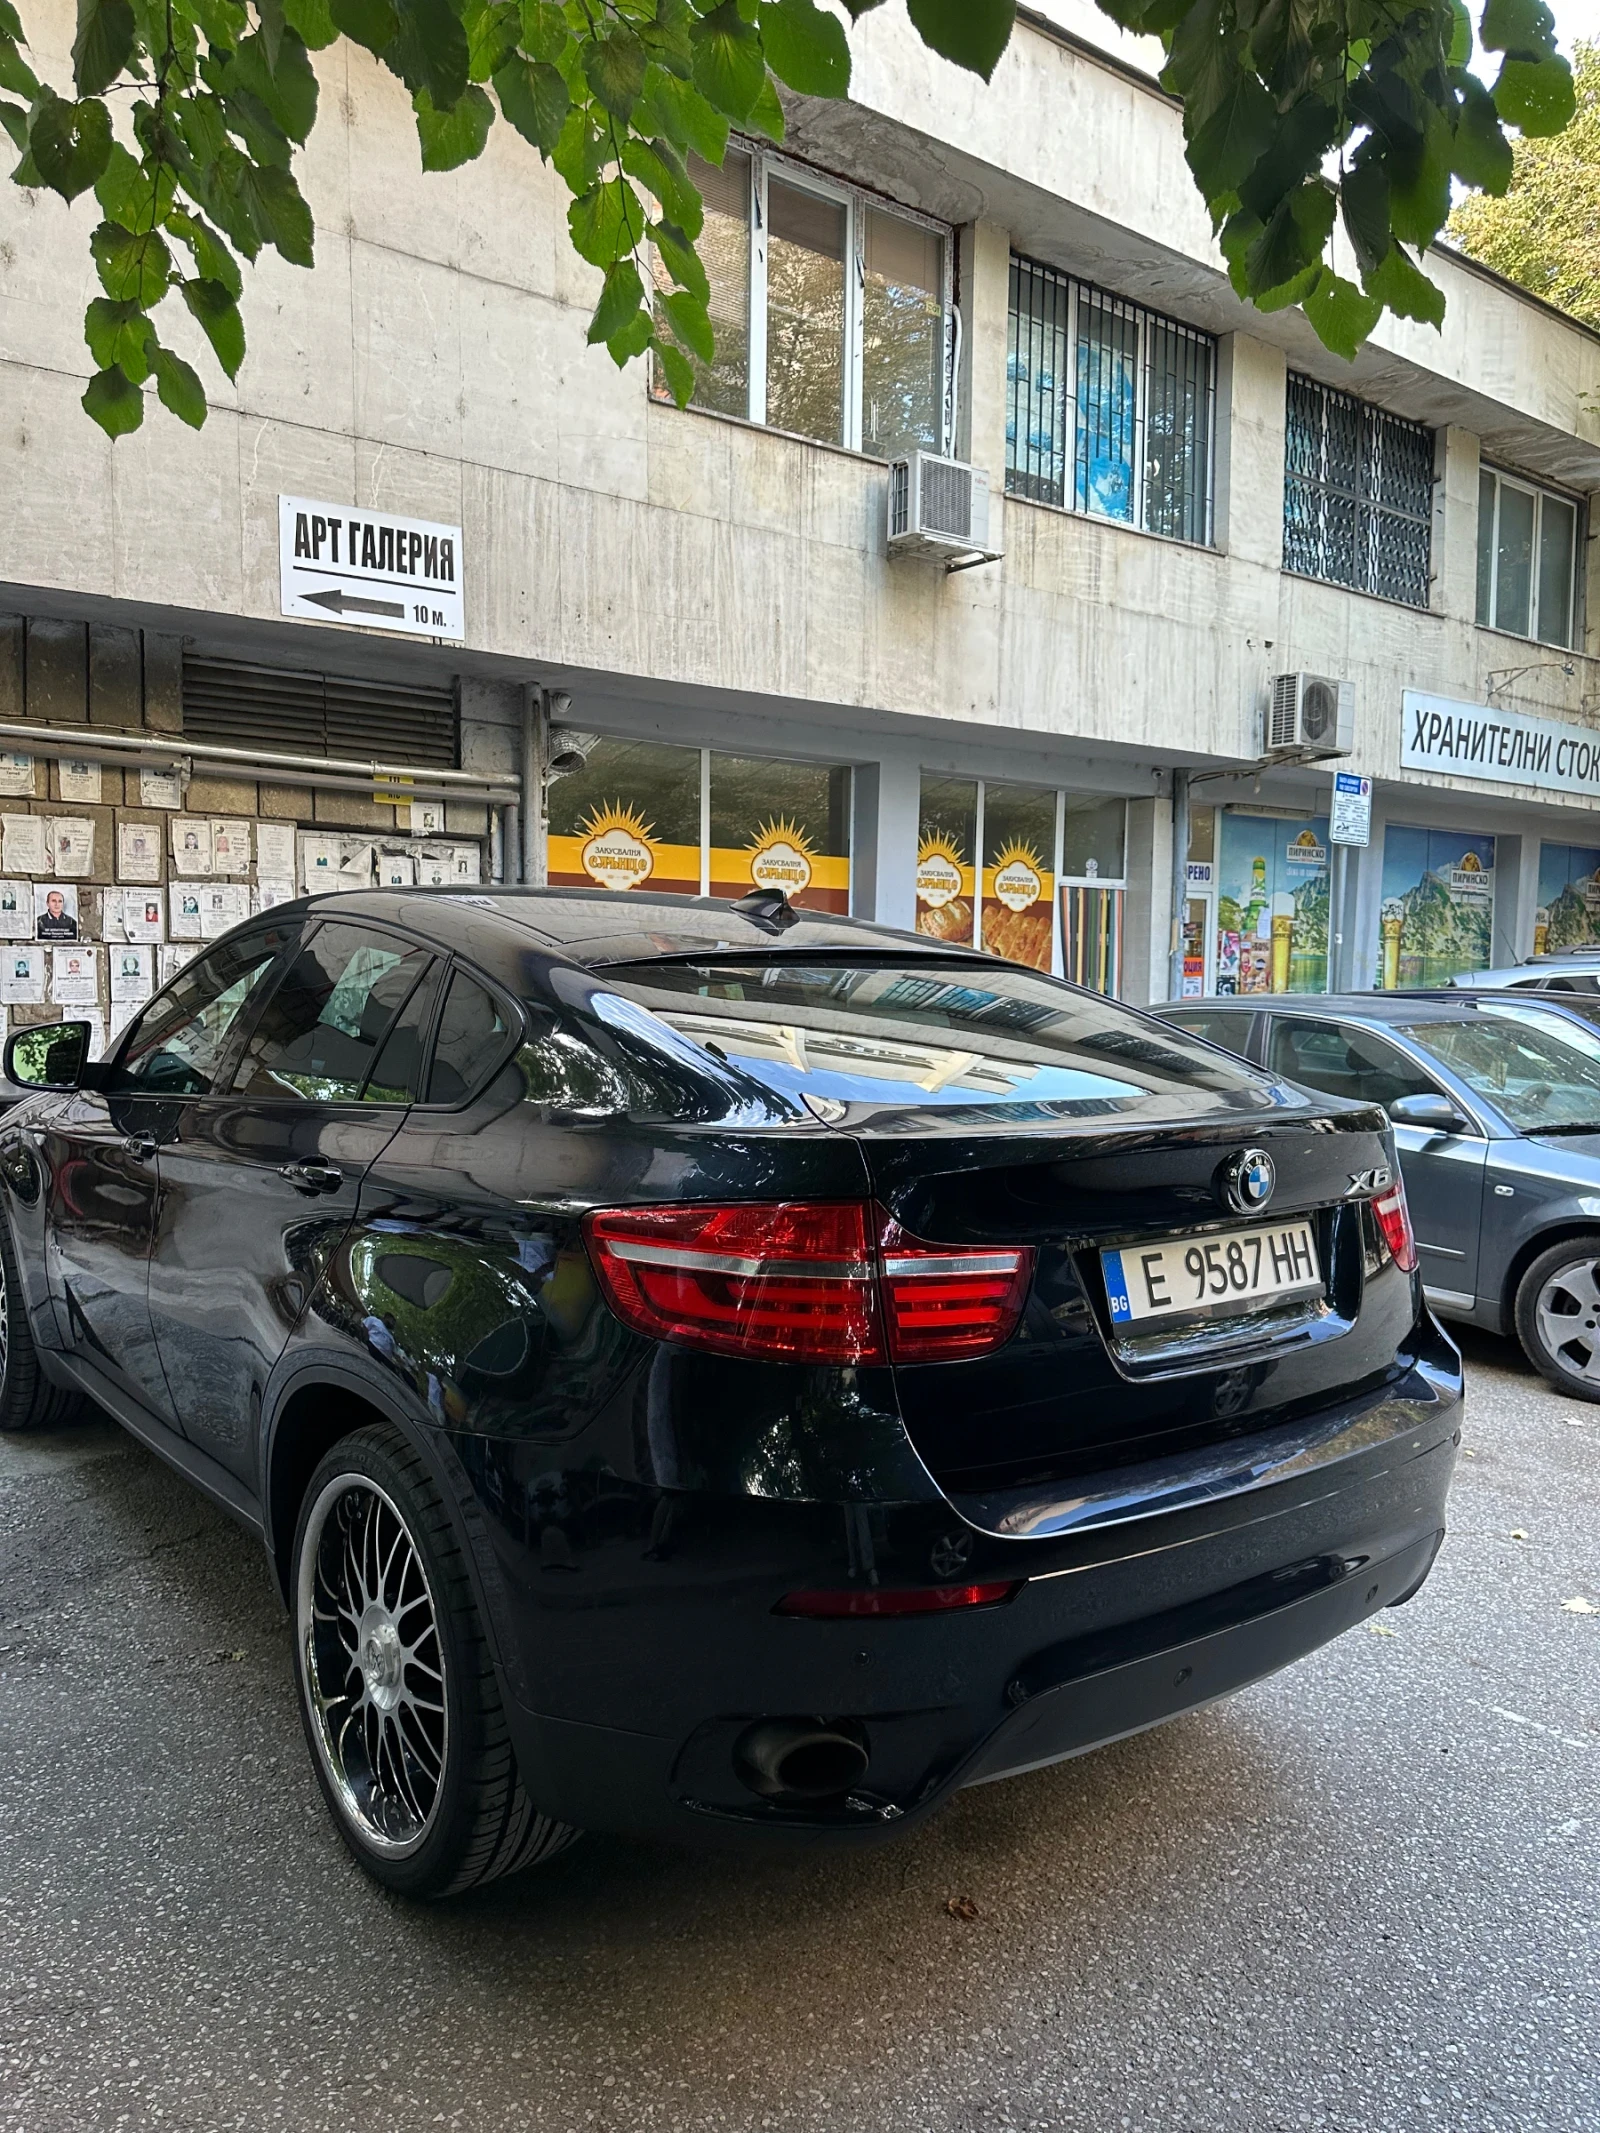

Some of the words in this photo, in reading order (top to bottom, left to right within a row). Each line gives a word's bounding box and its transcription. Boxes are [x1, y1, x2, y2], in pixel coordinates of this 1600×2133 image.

[295, 512, 342, 563] АРТ
[349, 520, 454, 582] ГАЛЕРИЯ
[413, 604, 429, 624] 10
[1411, 709, 1552, 773] ХРАНИТЕЛНИ
[595, 846, 641, 857] ЗАКУСВАЛНЯ
[761, 858, 802, 868] ЗАКУСВАЛНЯ
[1188, 865, 1210, 881] РЕНО
[1452, 872, 1488, 885] ПИРИНСКО
[1184, 960, 1202, 974] ОЦИЯ
[1343, 1165, 1390, 1196] X6
[1141, 1252, 1172, 1308] E
[1185, 1237, 1262, 1299] 9587
[1268, 1230, 1314, 1284] HH
[1110, 1294, 1129, 1315] BG
